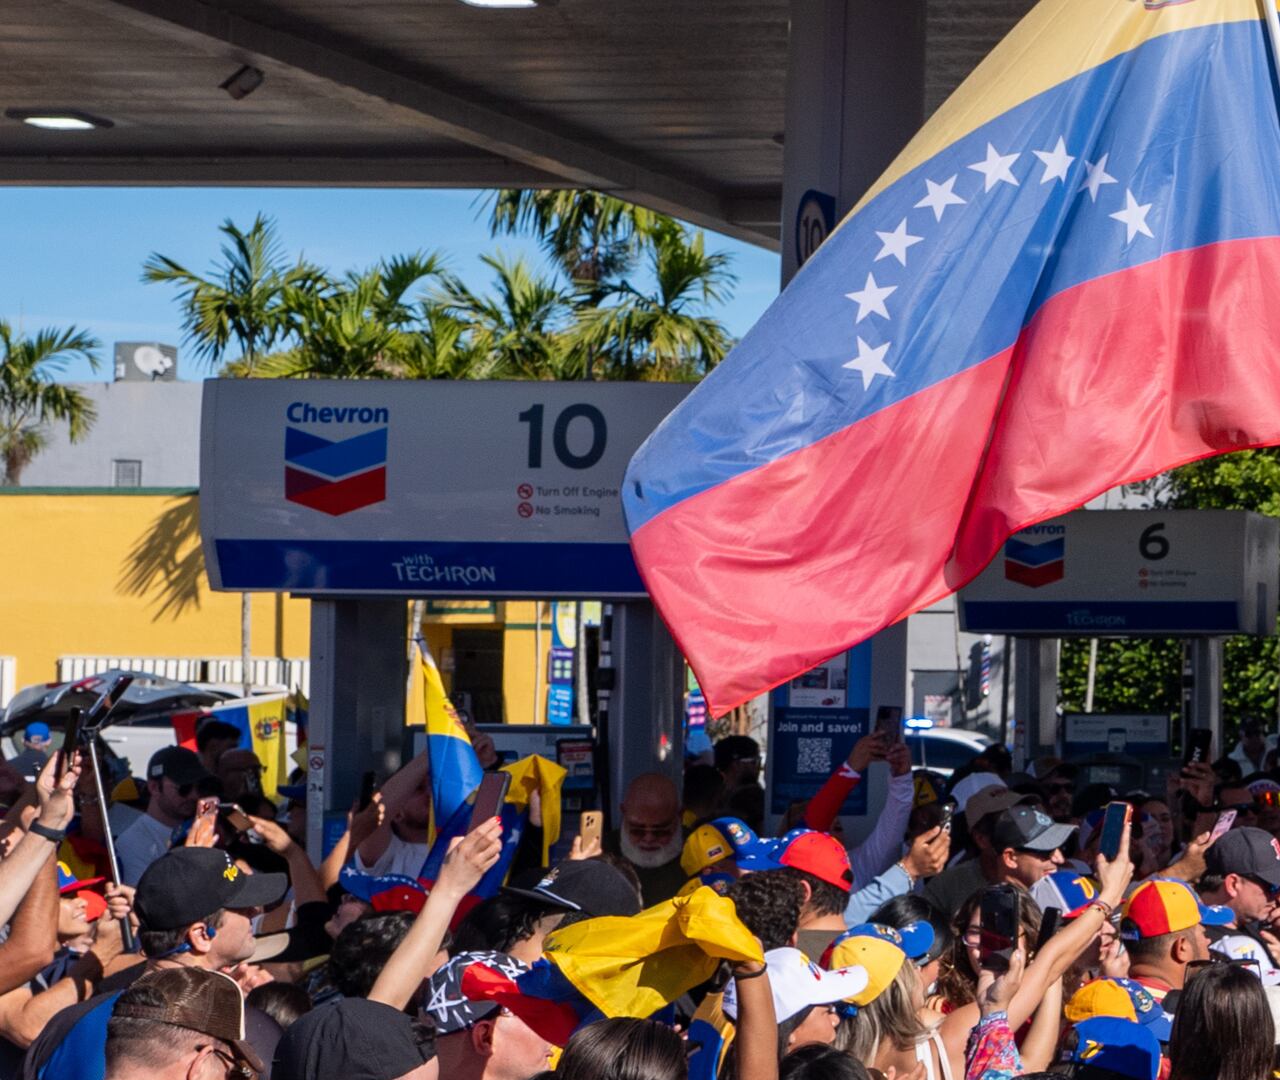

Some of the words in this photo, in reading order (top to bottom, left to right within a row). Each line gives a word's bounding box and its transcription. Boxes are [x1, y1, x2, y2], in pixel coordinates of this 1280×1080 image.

[286, 402, 389, 424] Chevron
[518, 403, 608, 470] 10
[536, 487, 560, 498] Turn
[563, 487, 579, 498] Off
[582, 487, 619, 499] Engine
[536, 505, 552, 516] No
[554, 505, 600, 518] Smoking
[1017, 523, 1066, 535] evron
[1139, 522, 1170, 561] 6
[402, 554, 433, 566] with
[392, 562, 496, 585] TECHRON
[778, 722, 799, 733] Join
[801, 722, 824, 733] and
[827, 722, 862, 733] save!
